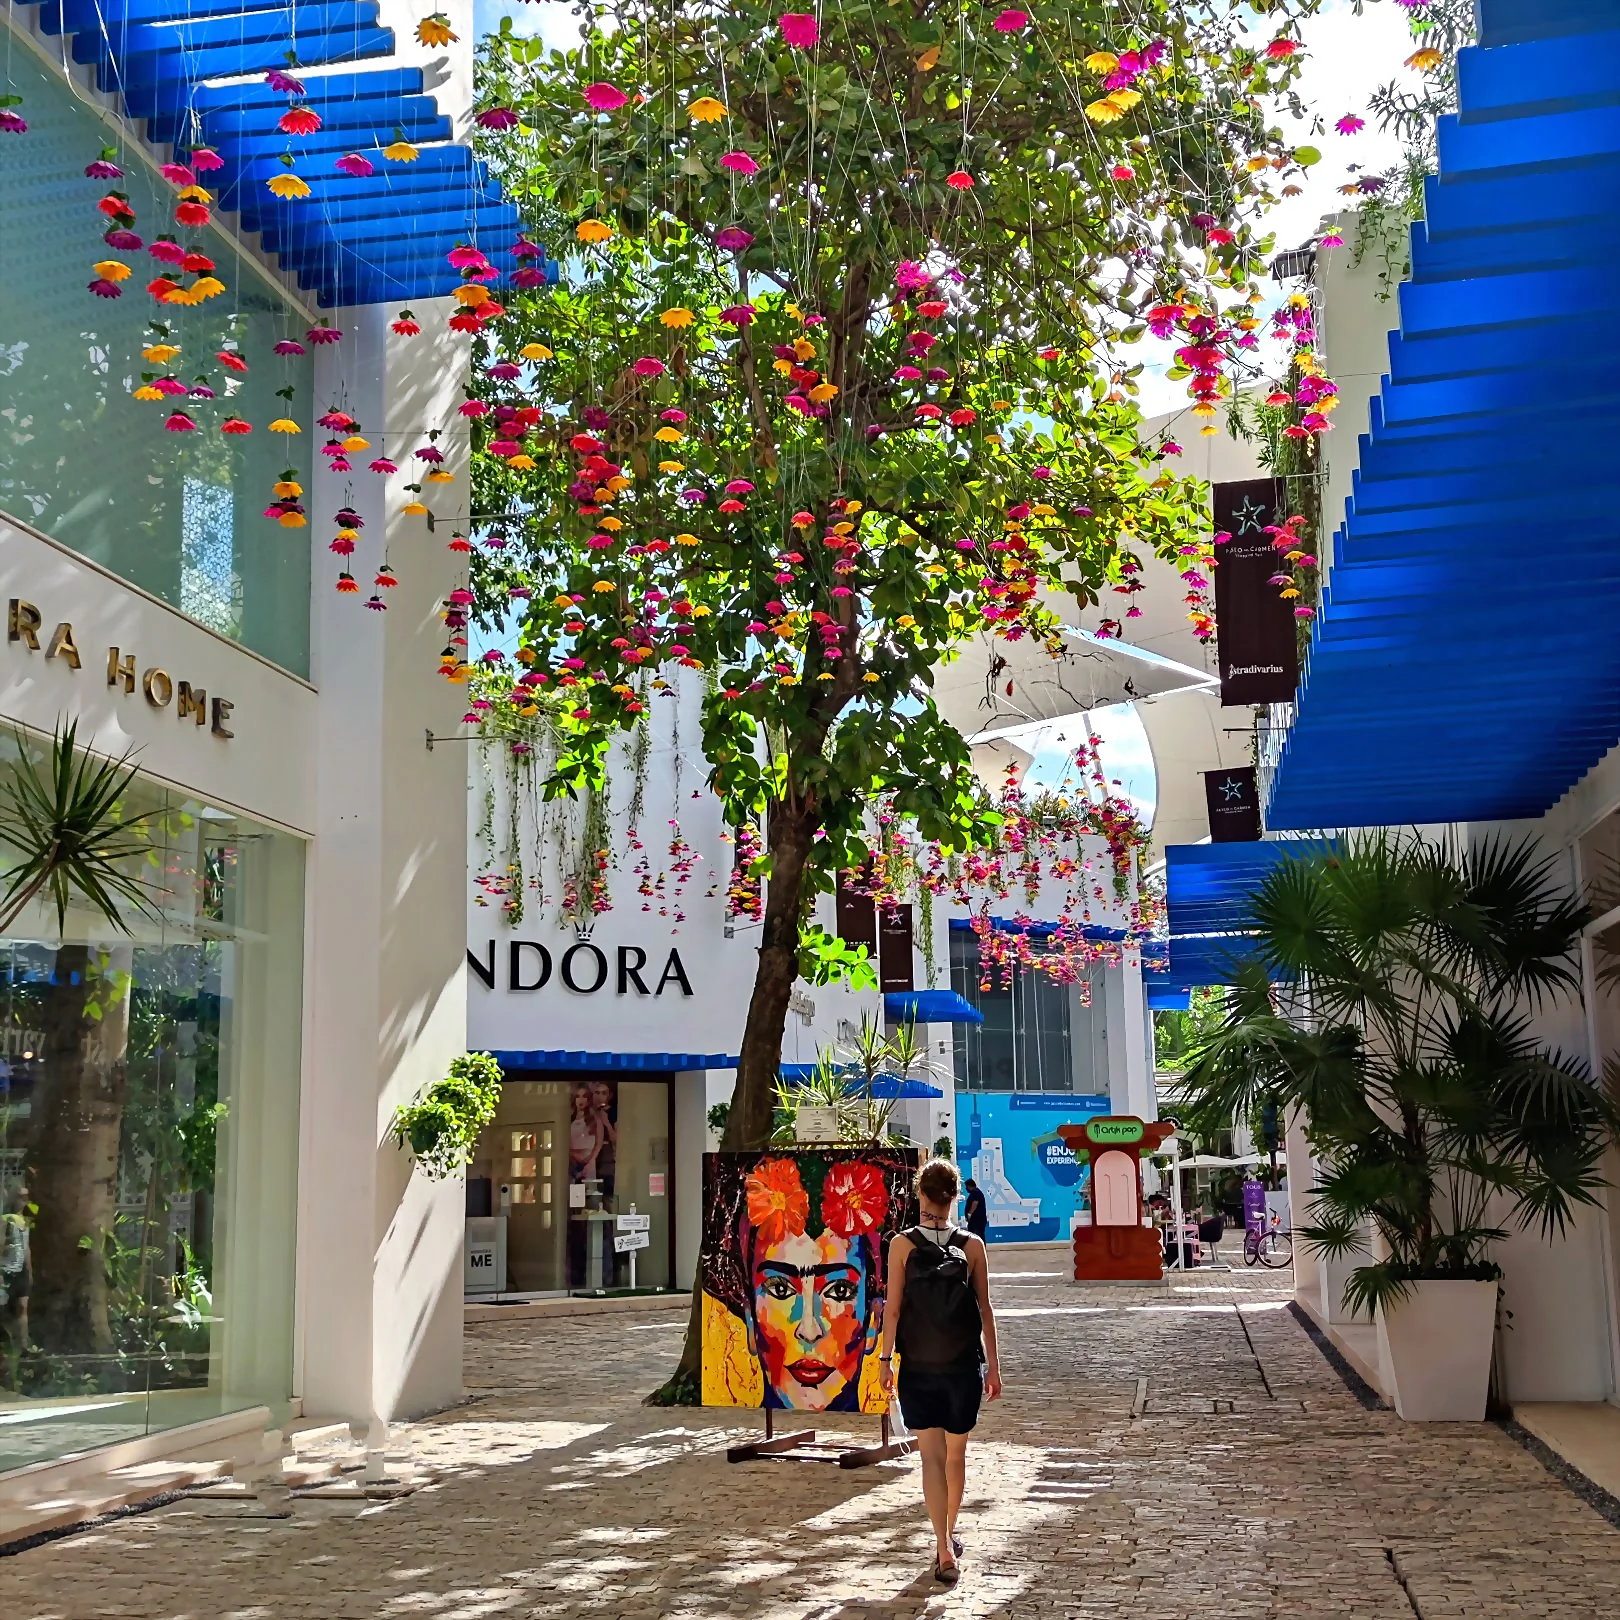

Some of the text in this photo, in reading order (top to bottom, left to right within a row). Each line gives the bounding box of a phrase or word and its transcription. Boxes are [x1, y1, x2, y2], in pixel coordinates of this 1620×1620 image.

[8, 598, 235, 739] RA HOME
[1122, 1126, 1137, 1135] pop
[471, 1254, 492, 1267] ME
